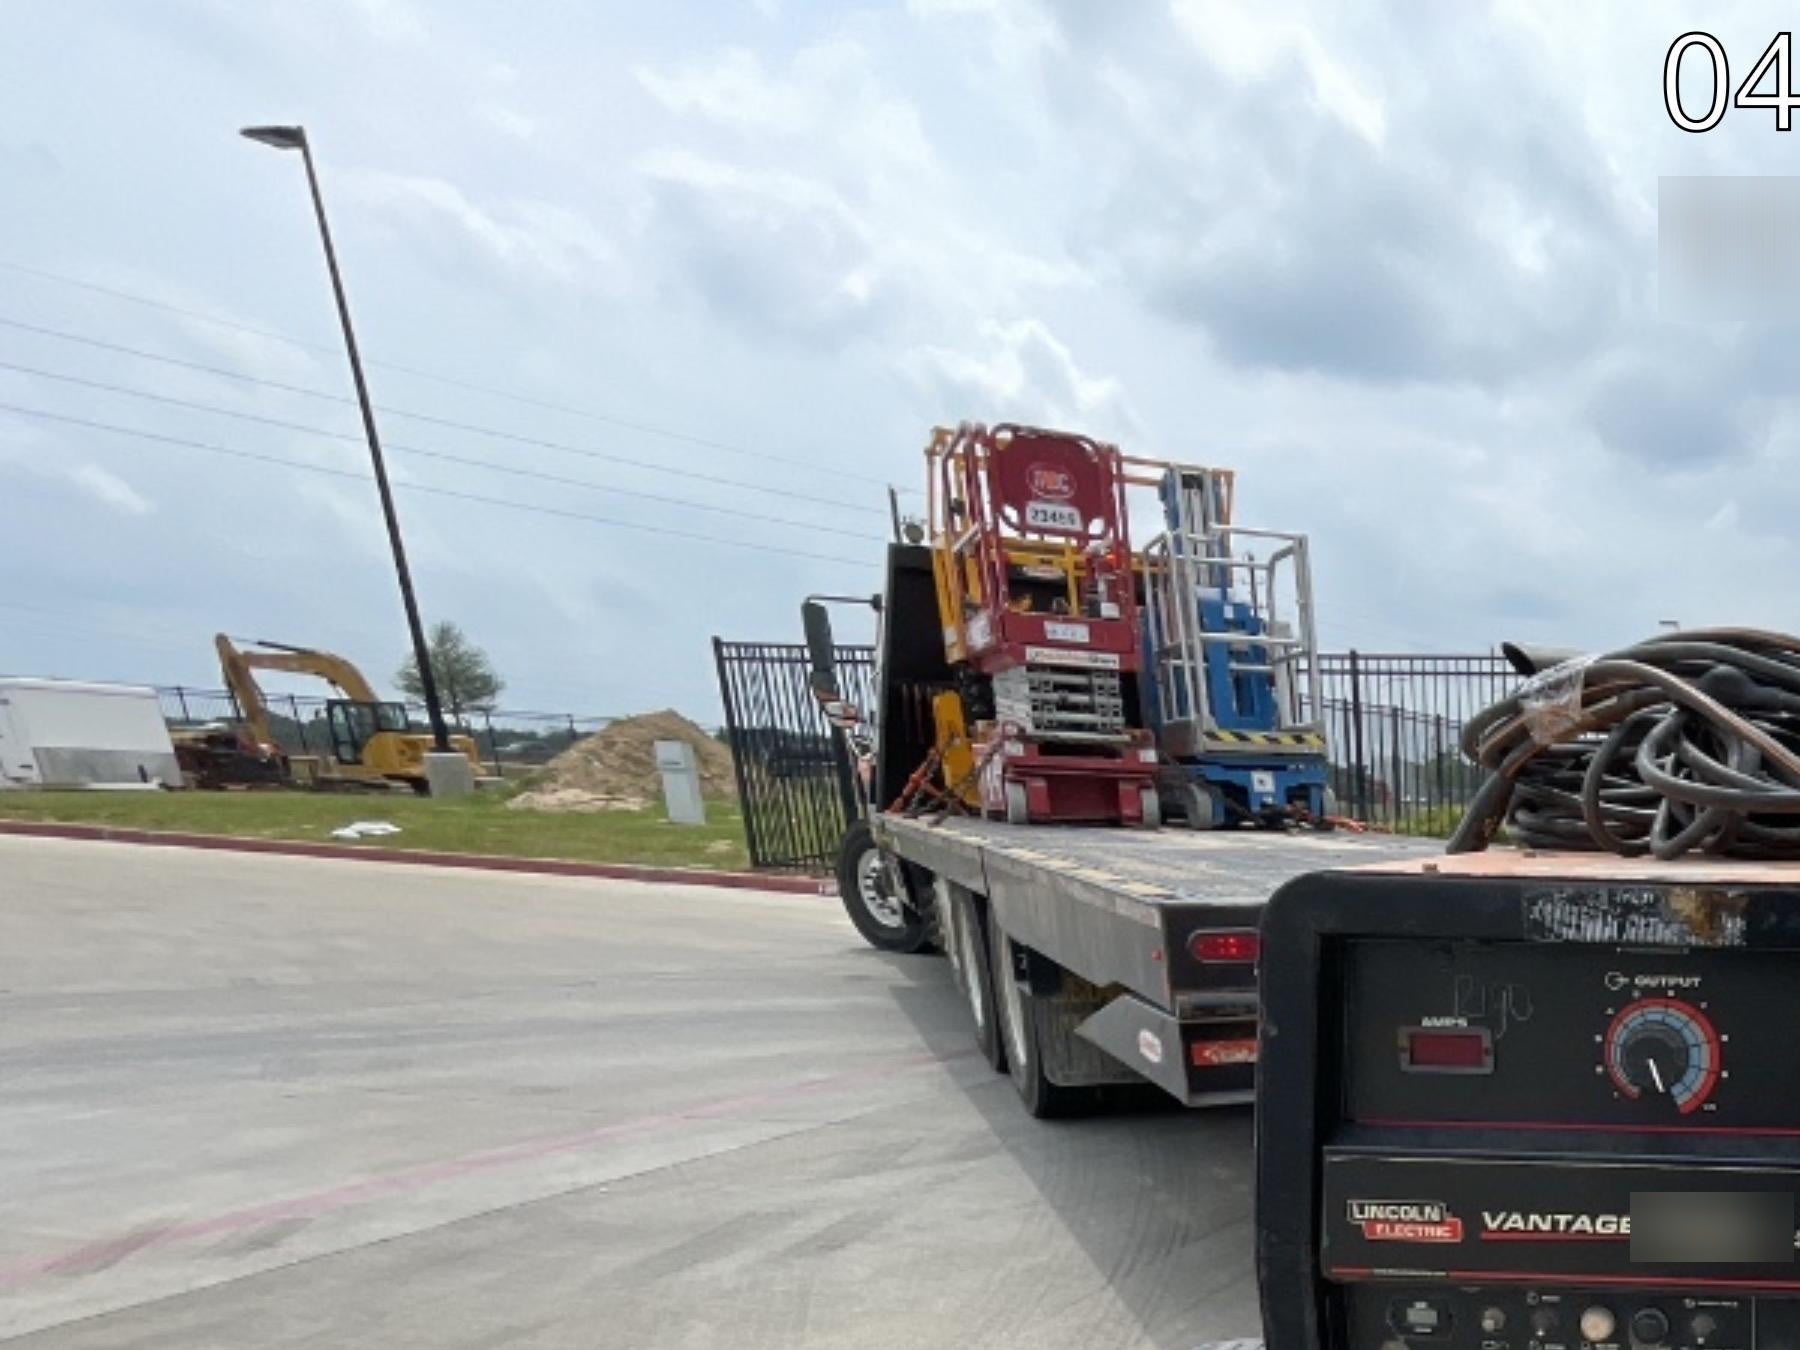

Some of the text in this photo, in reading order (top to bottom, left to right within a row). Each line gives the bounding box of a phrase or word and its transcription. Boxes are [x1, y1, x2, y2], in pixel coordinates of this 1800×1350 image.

[1634, 975, 1702, 988] OUTPUT
[1420, 1016, 1468, 1027] AMPS
[1352, 1203, 1441, 1222] LINCOLN
[1375, 1224, 1453, 1238] ELECTRIC
